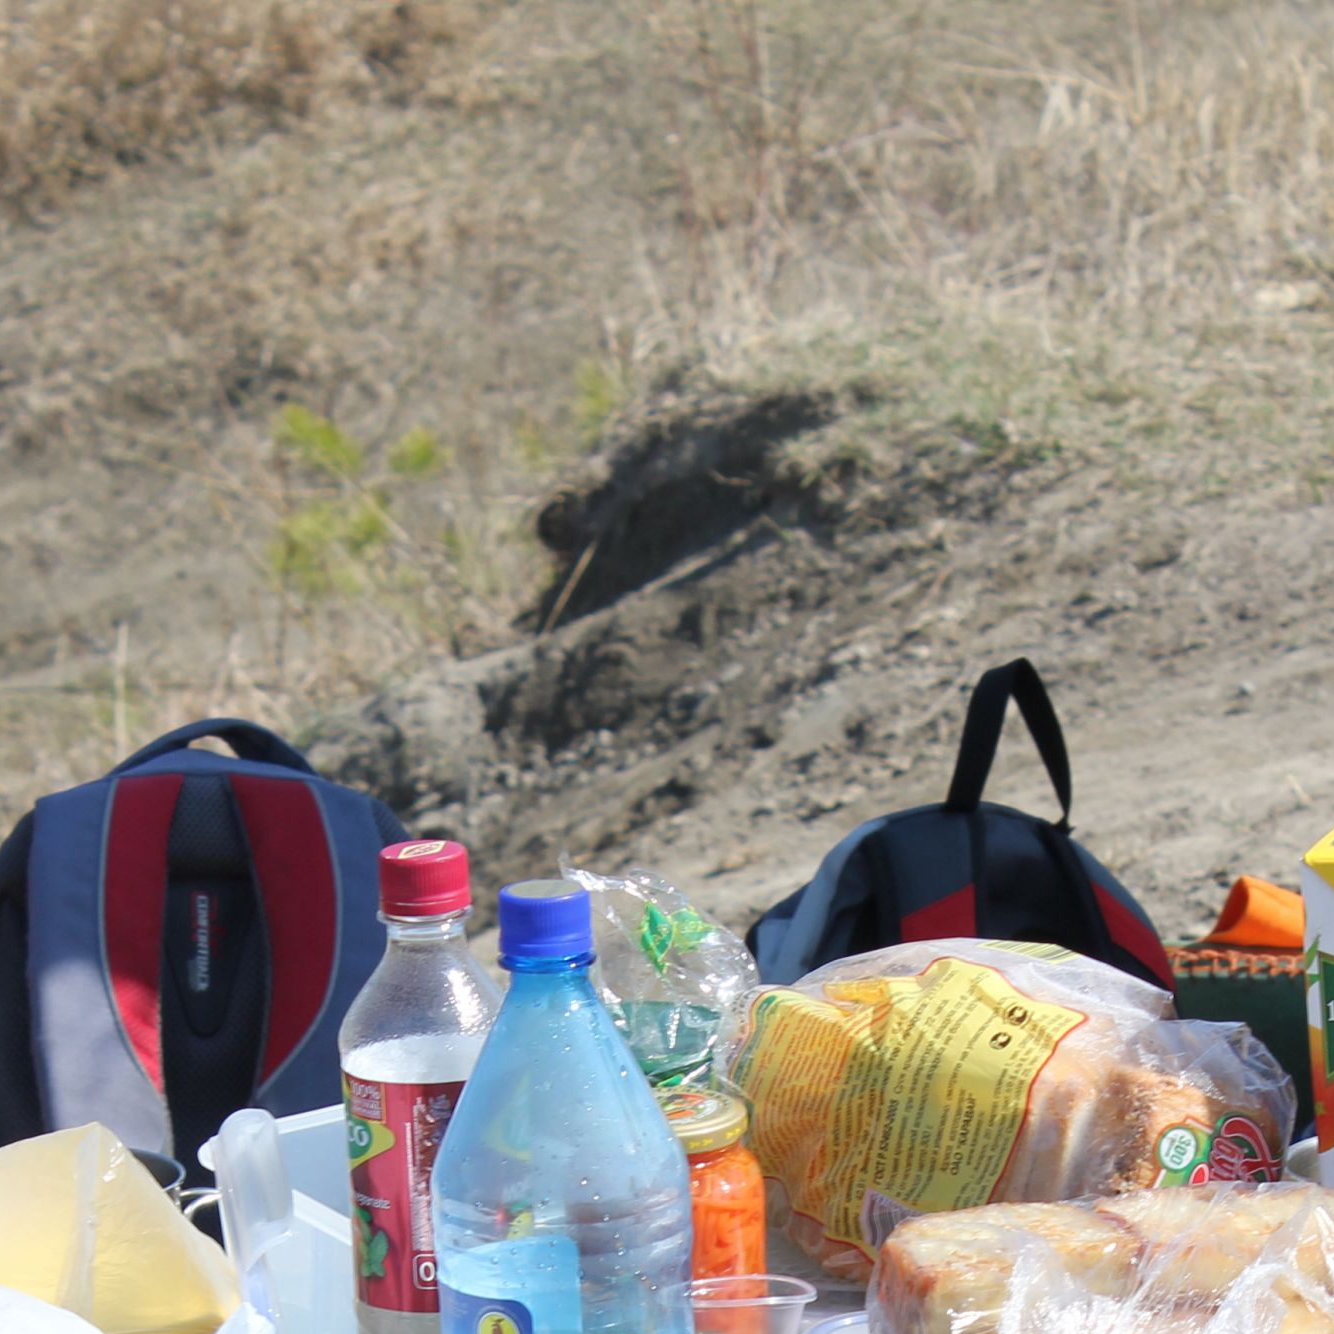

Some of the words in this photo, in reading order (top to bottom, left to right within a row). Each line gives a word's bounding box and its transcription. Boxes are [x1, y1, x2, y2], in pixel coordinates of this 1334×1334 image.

[1170, 1135, 1191, 1166] 300
[872, 1160, 885, 1184] ГОСТ
[948, 1151, 964, 1176] ОАО
